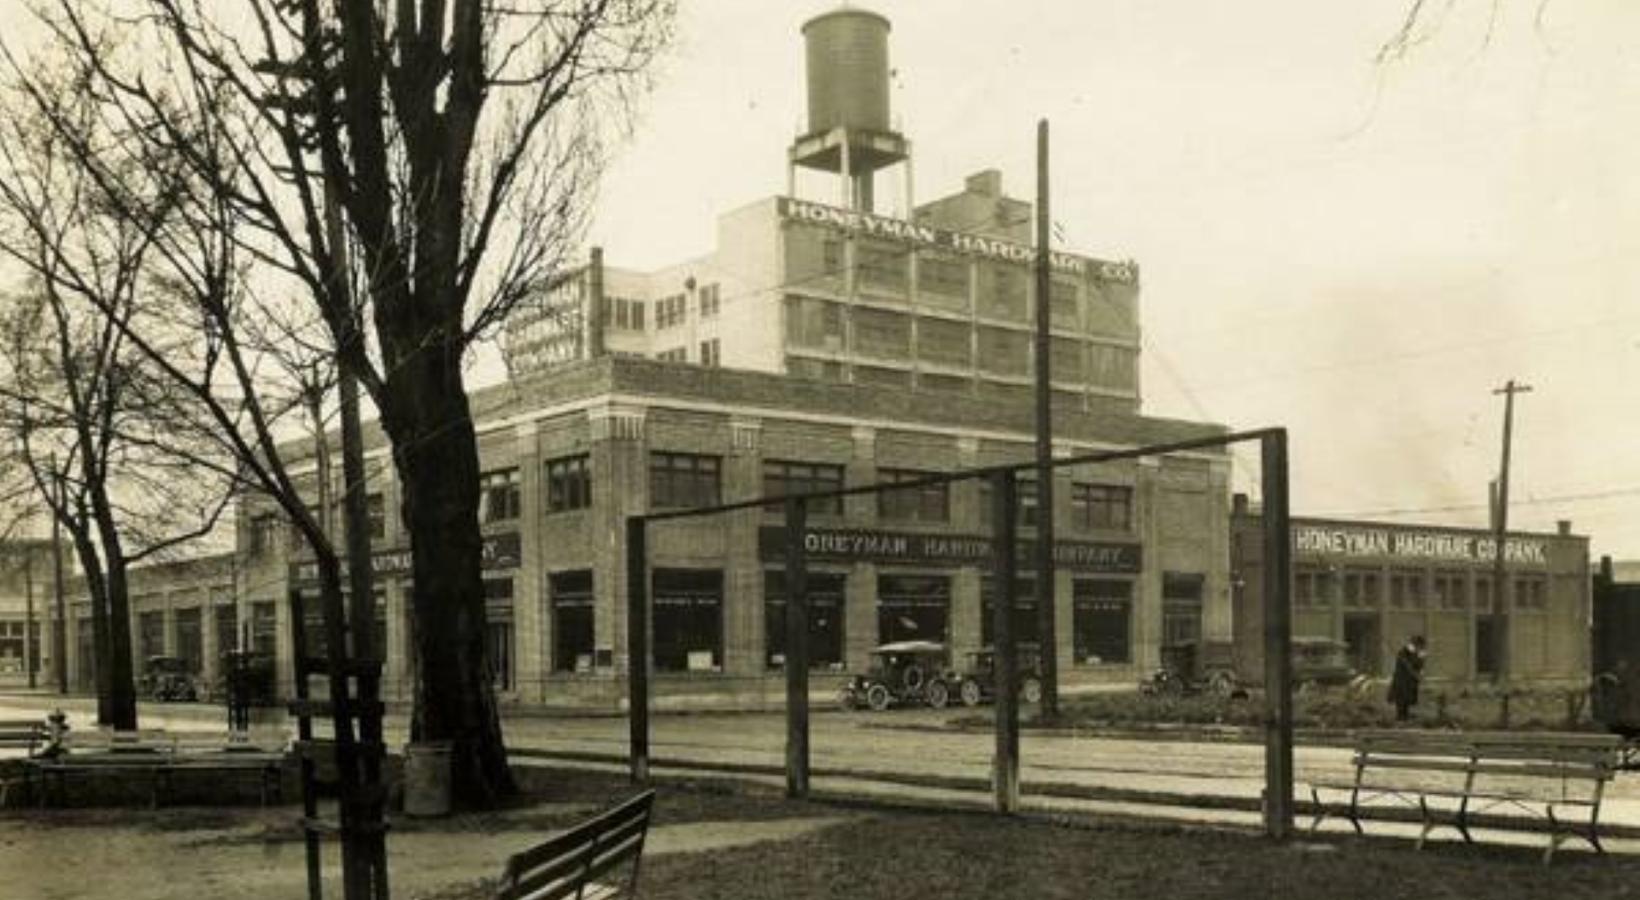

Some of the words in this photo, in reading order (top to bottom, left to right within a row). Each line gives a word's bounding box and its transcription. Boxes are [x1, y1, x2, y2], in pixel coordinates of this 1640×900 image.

[788, 200, 935, 243] HONEYMAN
[790, 532, 907, 555] ONEYMAN
[1037, 545, 1122, 565] OMPANY
[1297, 529, 1389, 555] HONEYMAN
[1395, 533, 1472, 560] HARDWARE
[1477, 538, 1546, 564] COPANY
